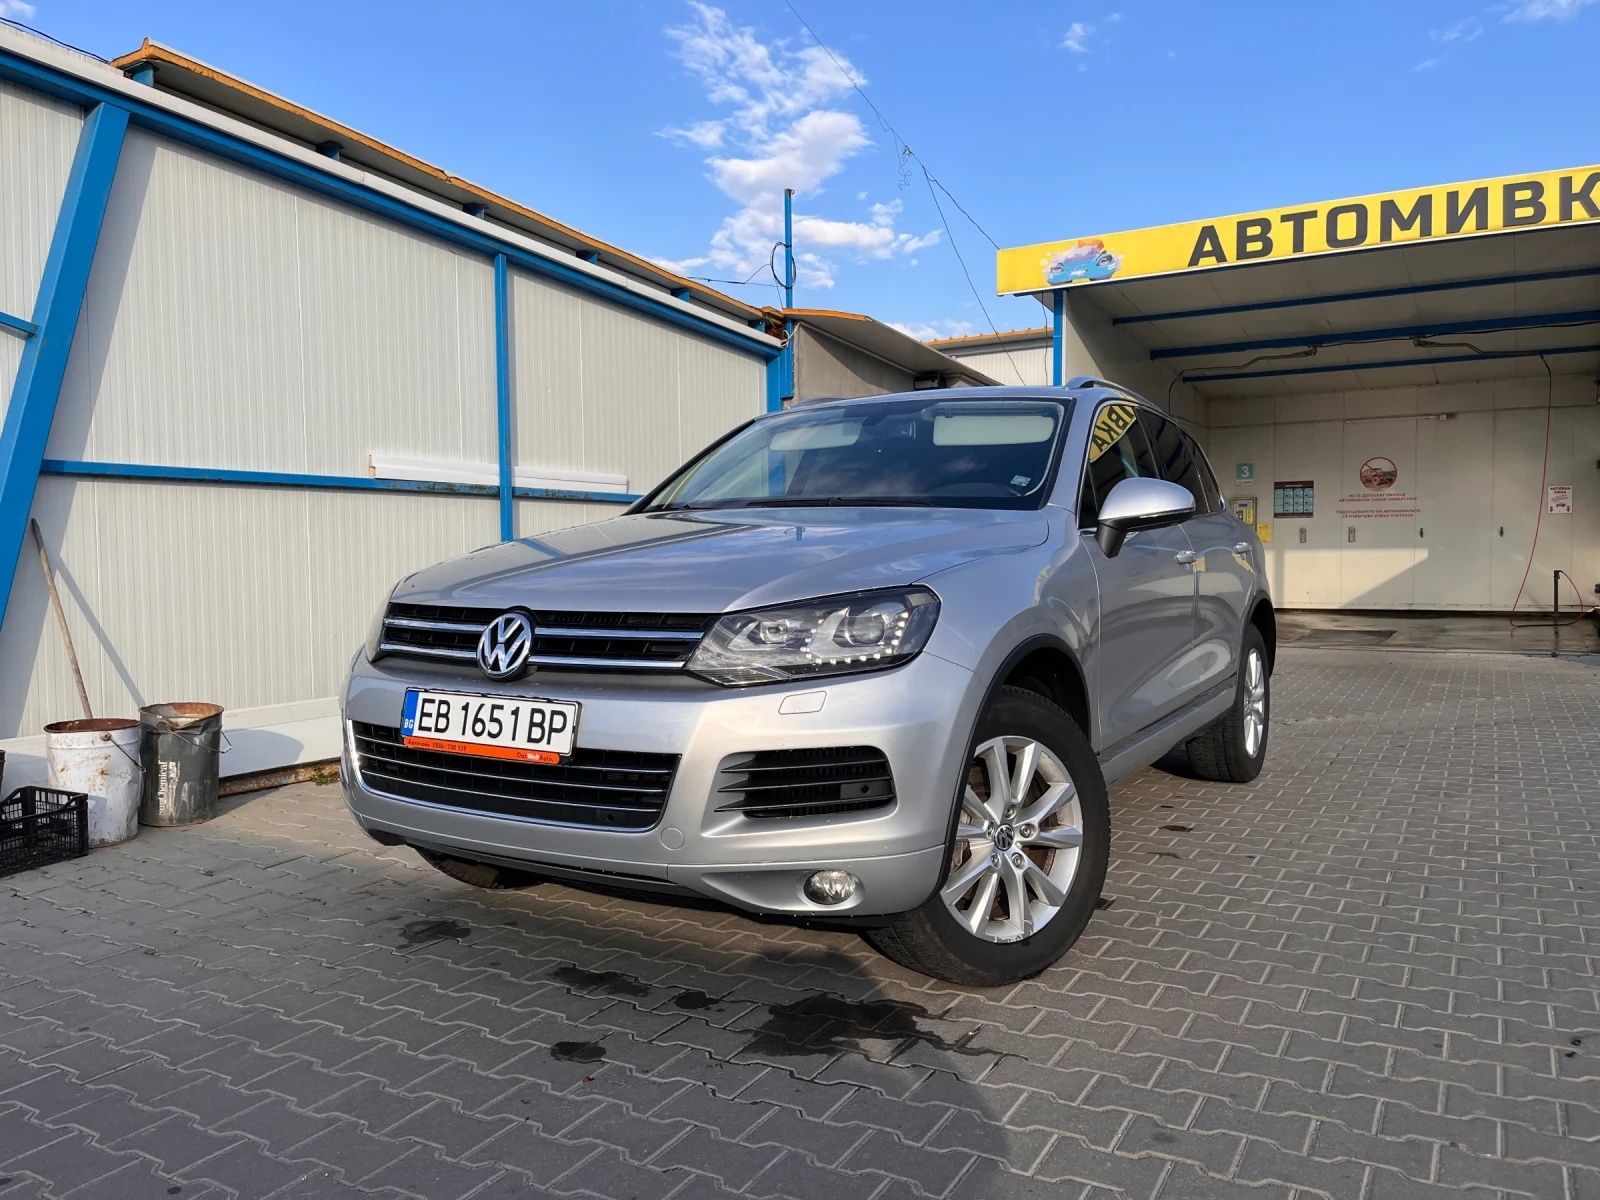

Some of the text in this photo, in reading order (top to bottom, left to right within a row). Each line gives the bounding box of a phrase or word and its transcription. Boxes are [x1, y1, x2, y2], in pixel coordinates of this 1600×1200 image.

[1187, 171, 1600, 267] АВТОМИВК
[1241, 465, 1250, 478] 3
[403, 718, 414, 729] BG
[418, 698, 568, 745] EB 1651 BP
